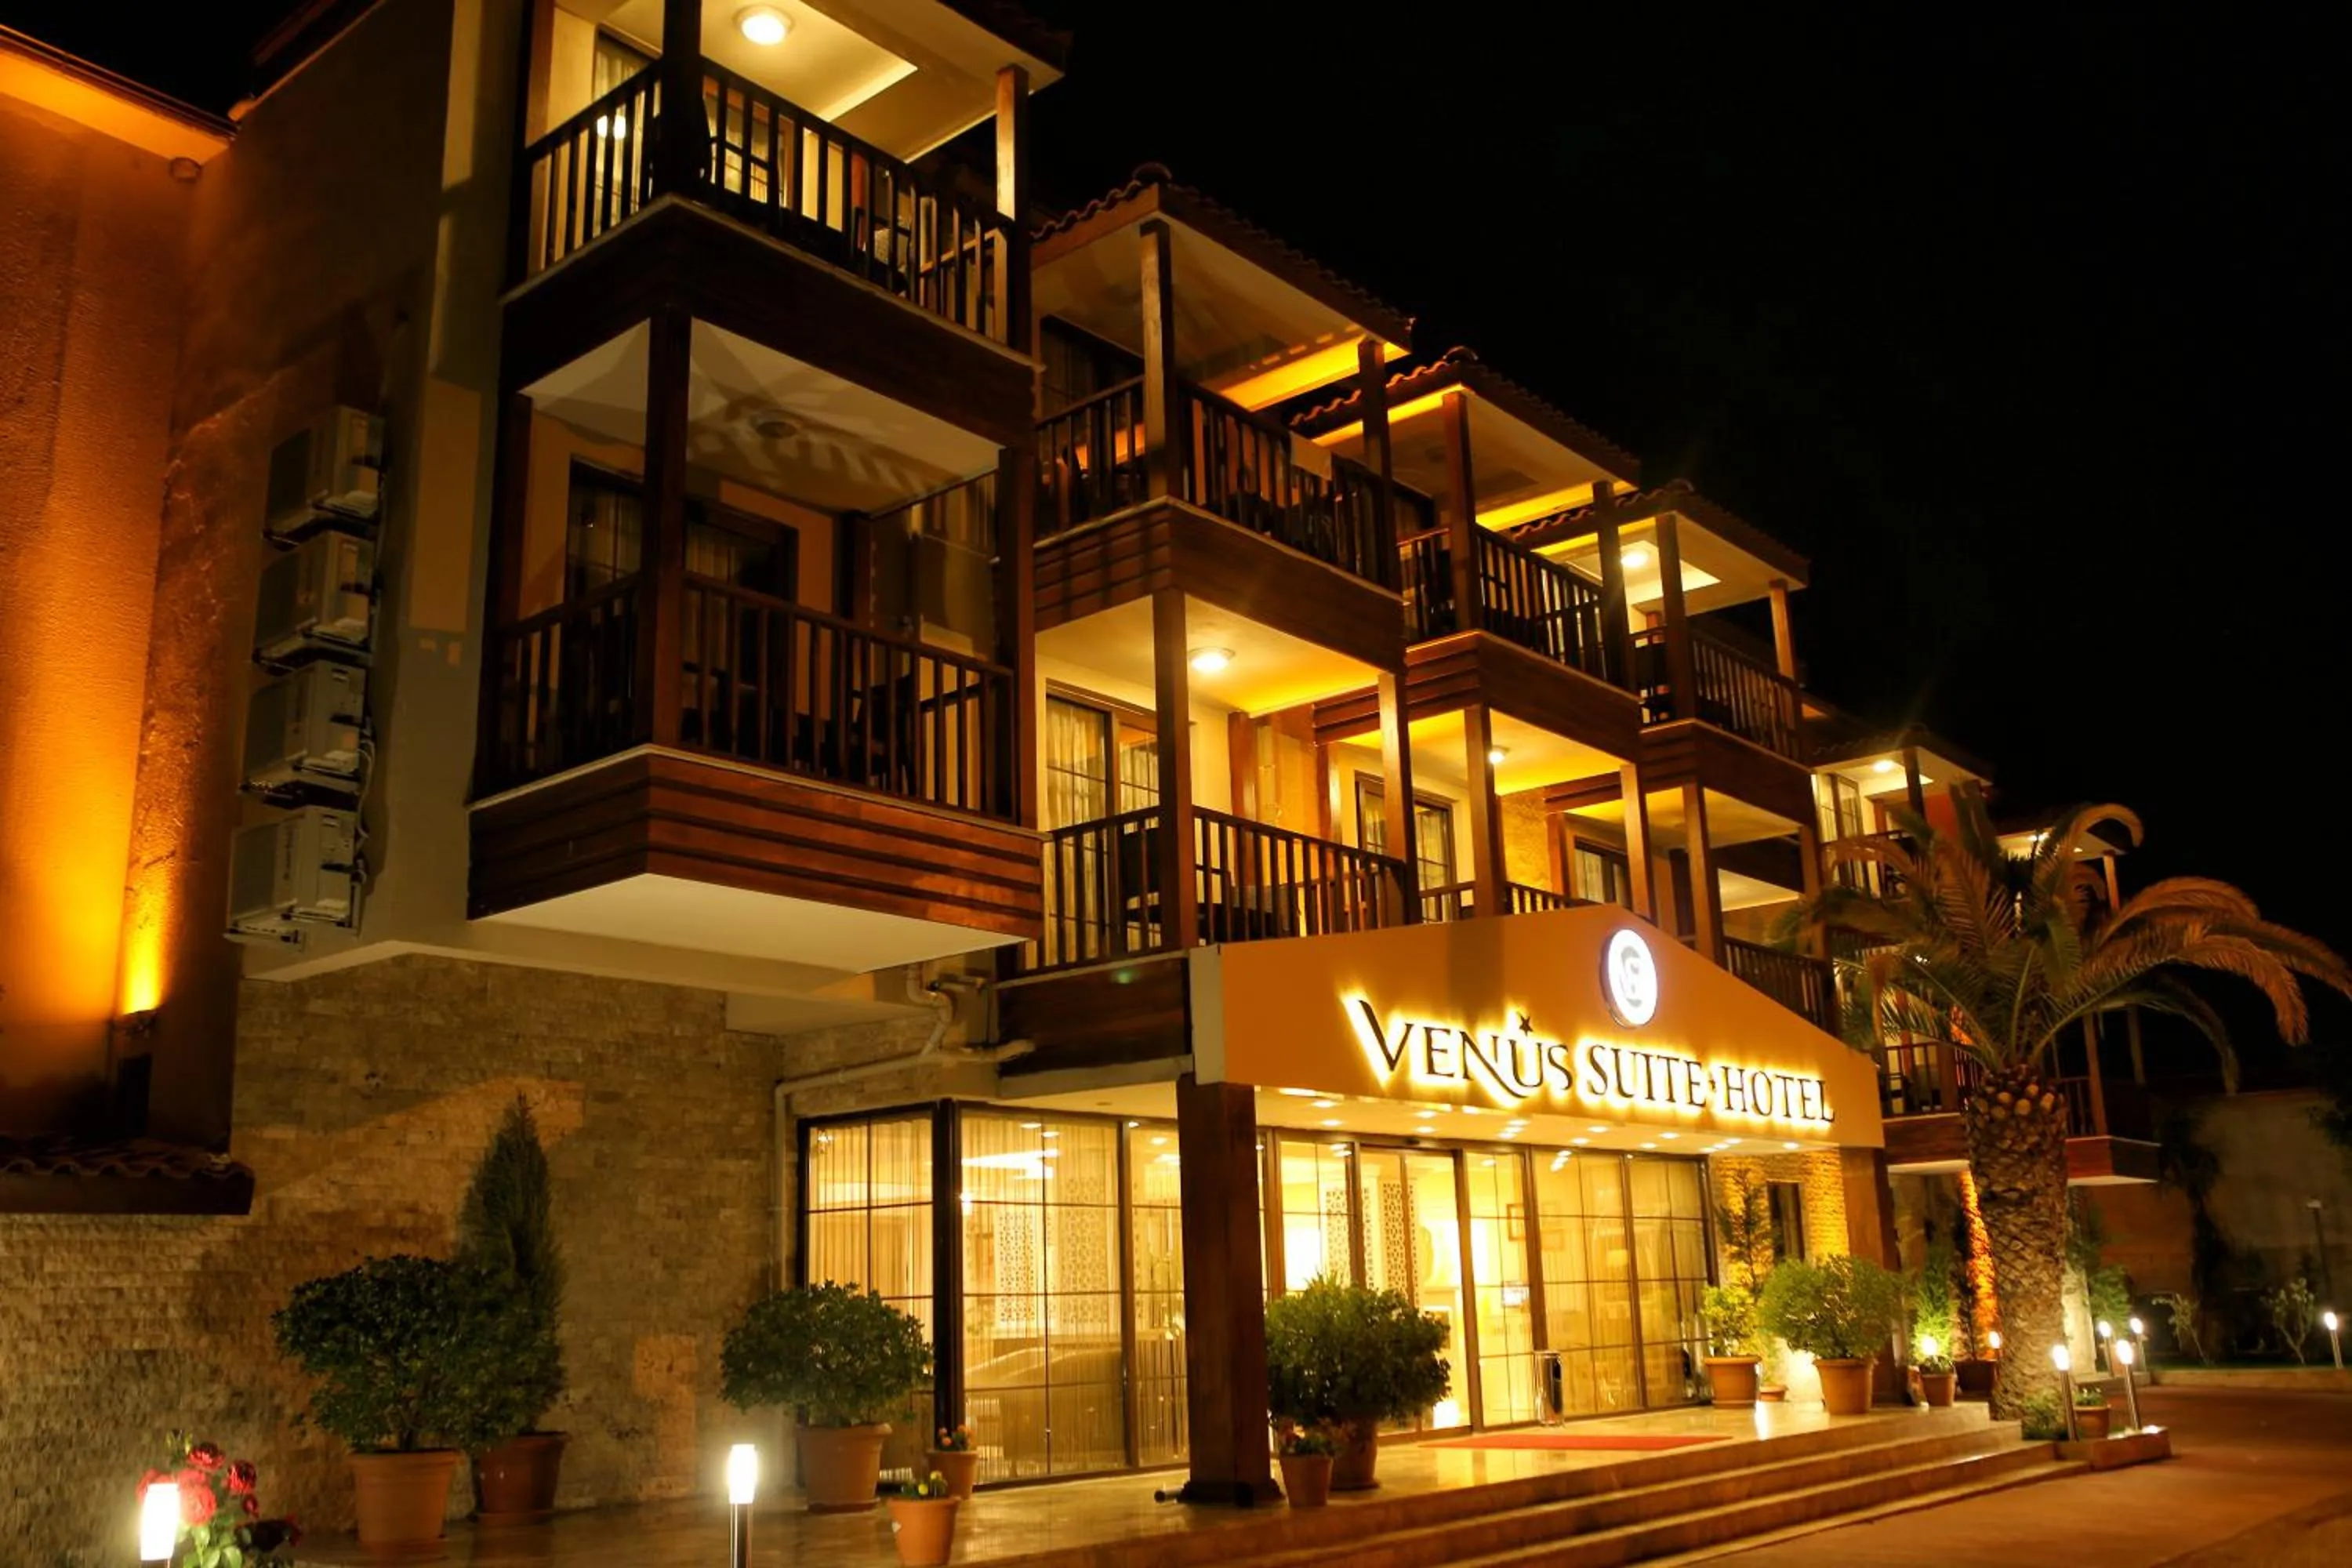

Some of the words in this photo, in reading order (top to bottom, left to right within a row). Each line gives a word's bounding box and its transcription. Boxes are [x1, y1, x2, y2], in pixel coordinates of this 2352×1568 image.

[1359, 1000, 1573, 1098] VENUS
[1588, 1044, 1707, 1108] SUITE
[1721, 1065, 1835, 1122] HOTEL
